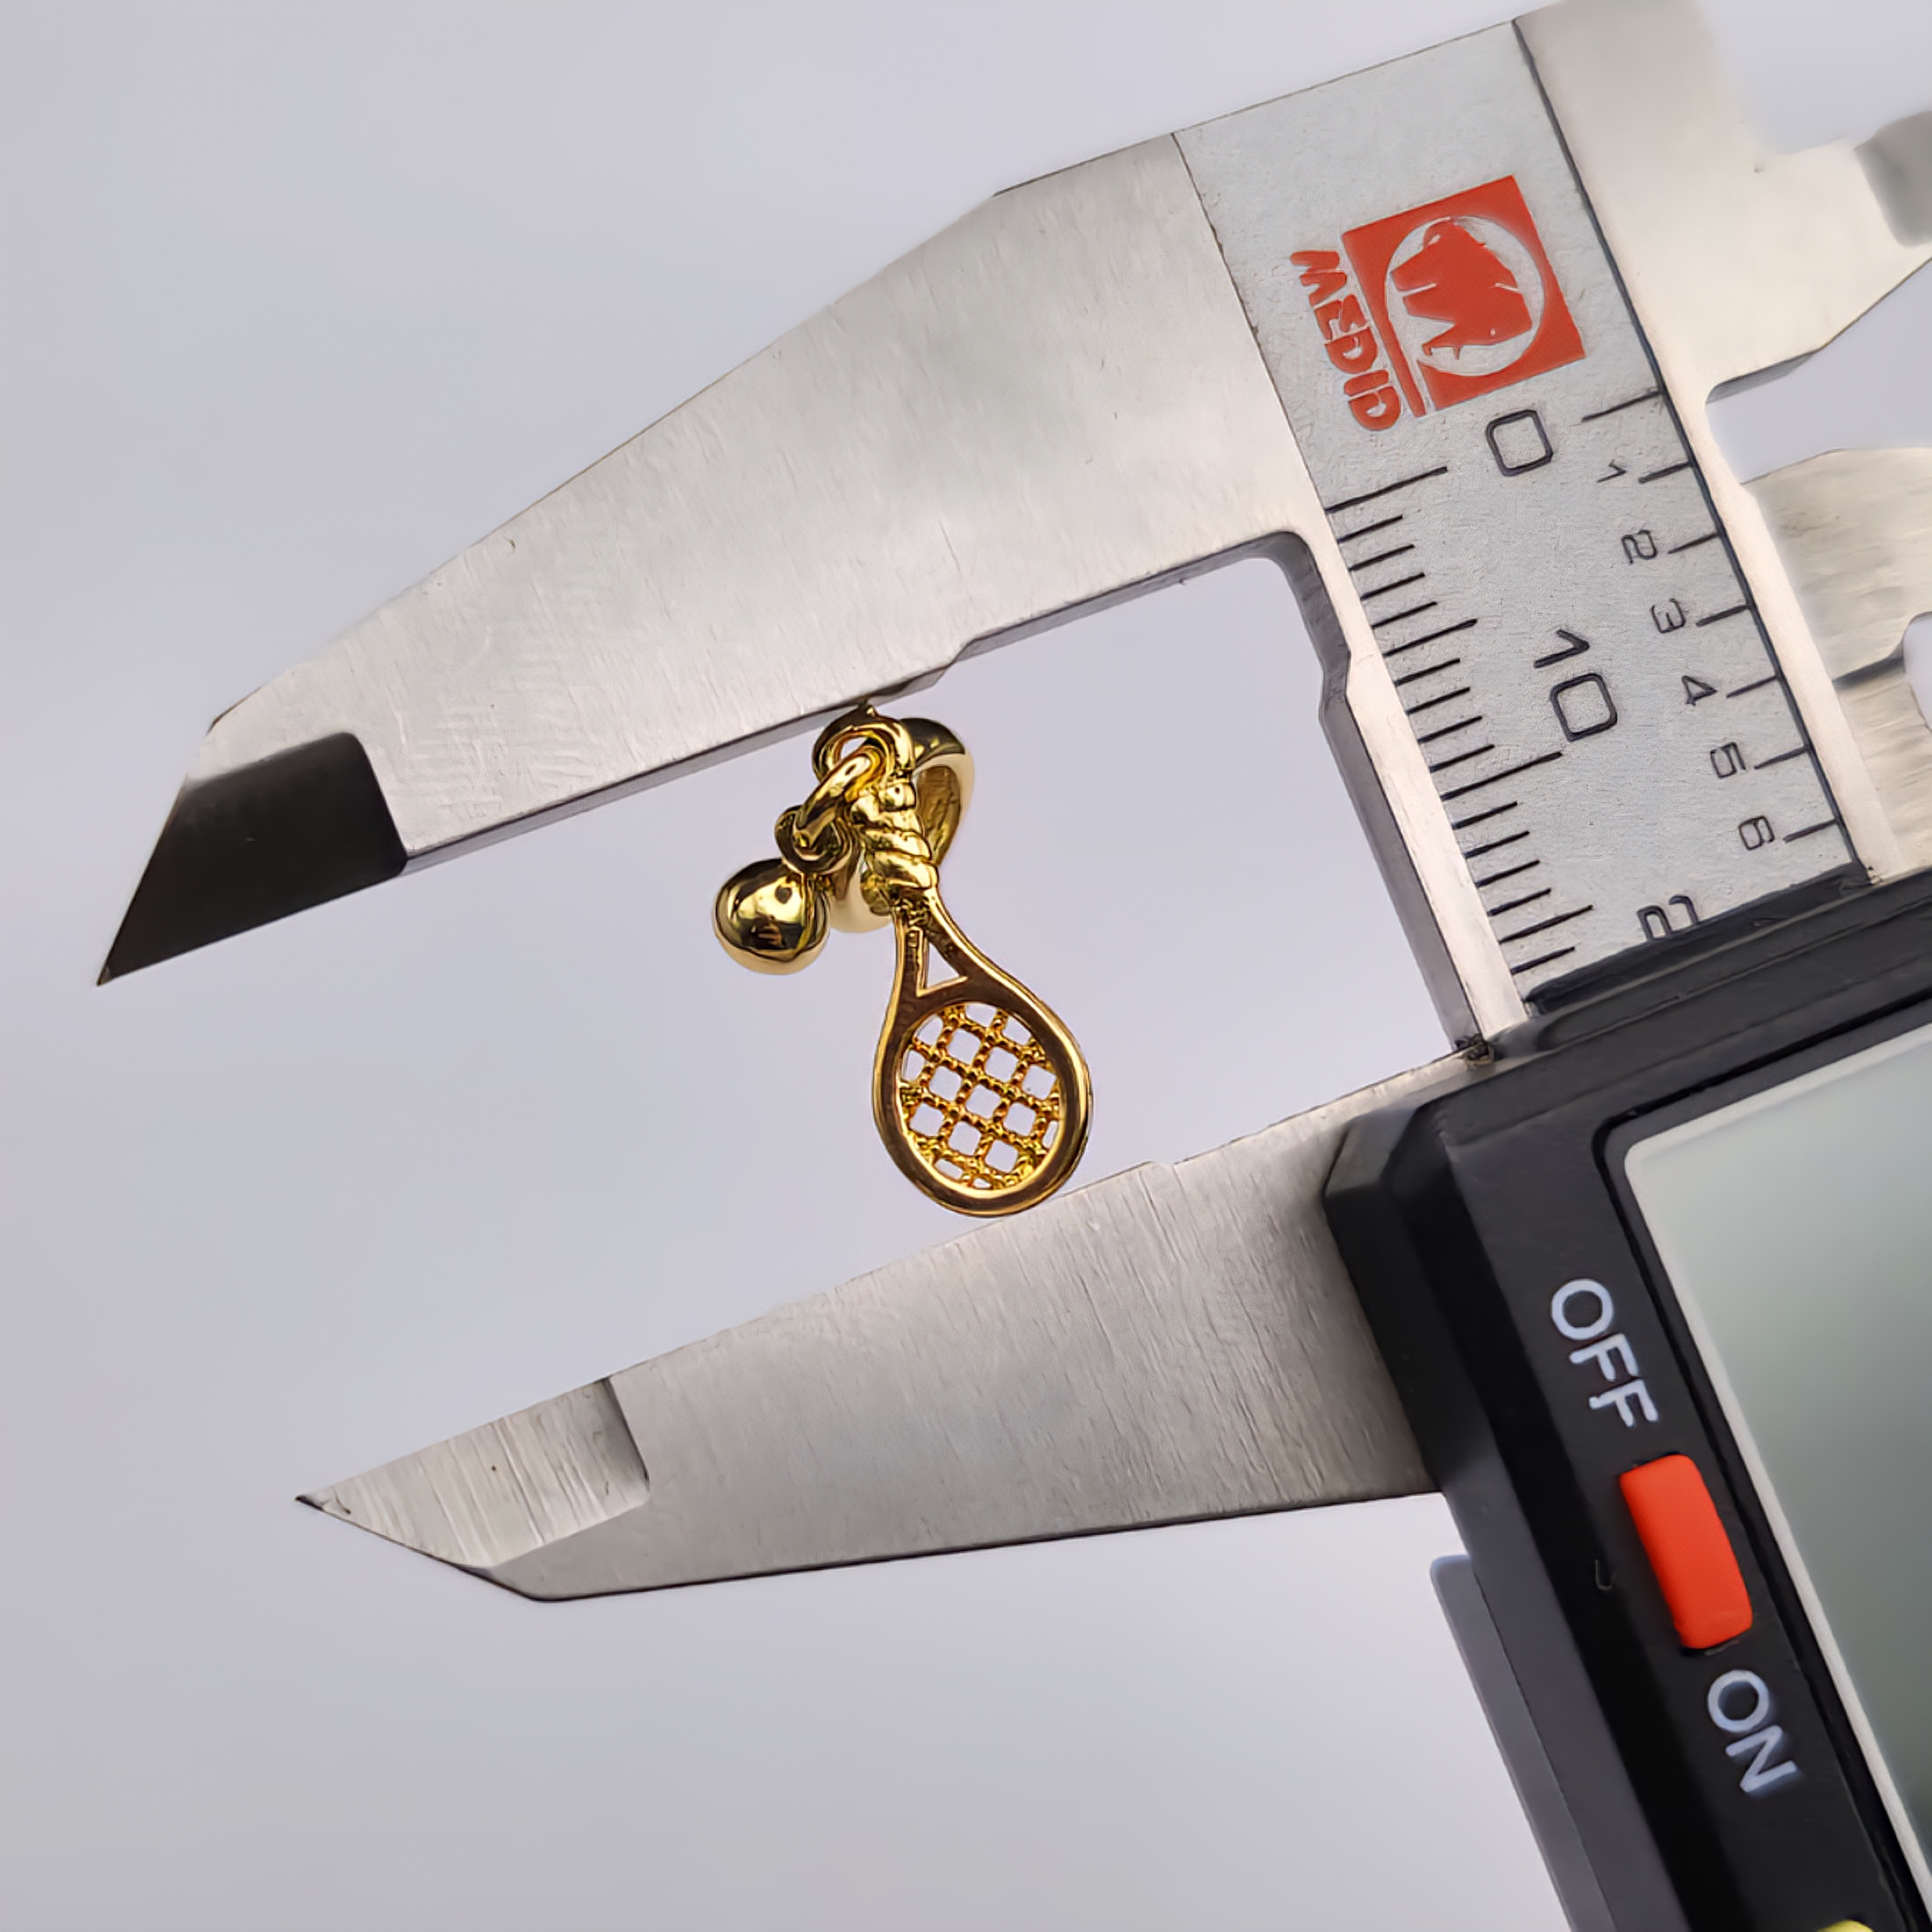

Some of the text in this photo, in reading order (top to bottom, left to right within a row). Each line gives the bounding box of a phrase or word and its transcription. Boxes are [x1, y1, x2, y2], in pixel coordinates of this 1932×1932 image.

[1289, 249, 1401, 432] MEDID
[1485, 409, 1554, 478] 0
[1533, 629, 1618, 742] 10
[1596, 459, 1775, 851] 1 2 3 4 5 6
[1550, 1277, 1659, 1428] OFF
[1707, 1669, 1798, 1794] ON
